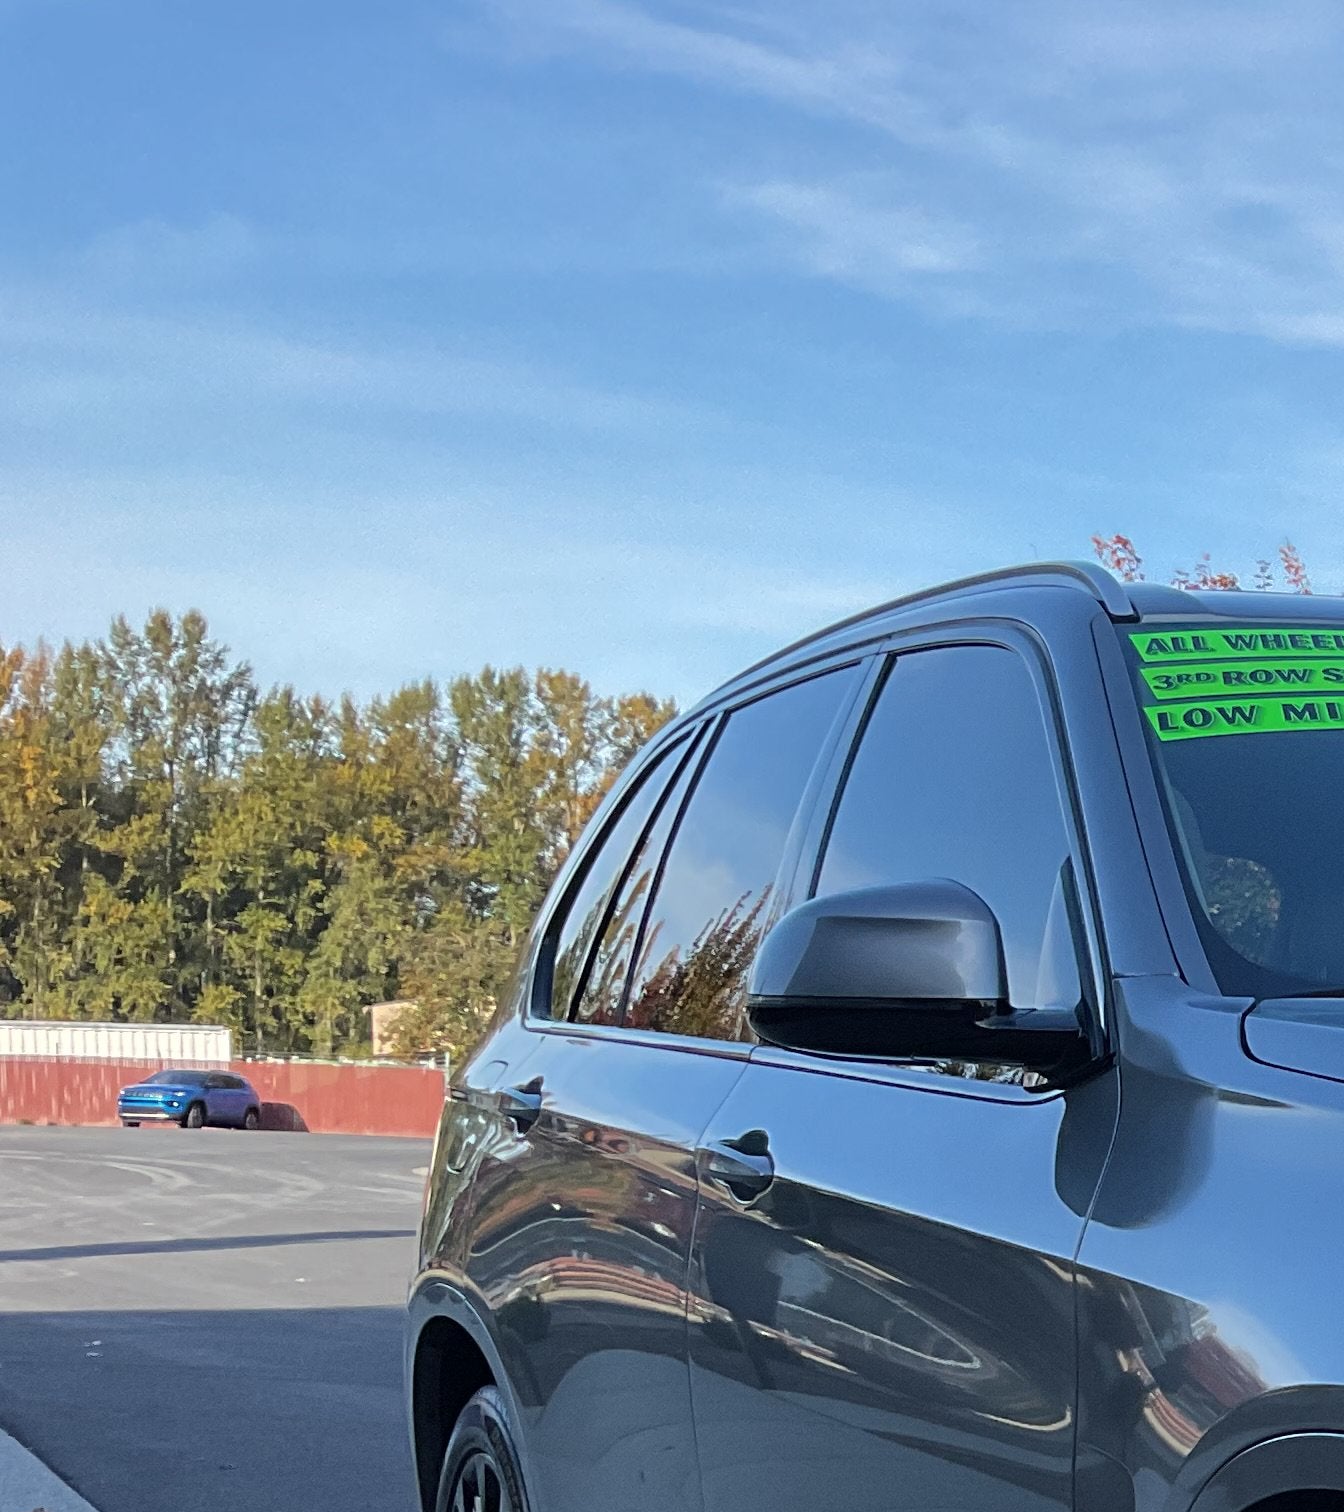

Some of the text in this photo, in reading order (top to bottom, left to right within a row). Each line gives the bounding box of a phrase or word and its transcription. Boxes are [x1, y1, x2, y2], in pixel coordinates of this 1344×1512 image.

[1144, 633, 1215, 656] ALL
[1152, 671, 1216, 691] 3RD
[1222, 667, 1312, 687] ROW
[1156, 704, 1257, 733] LOW
